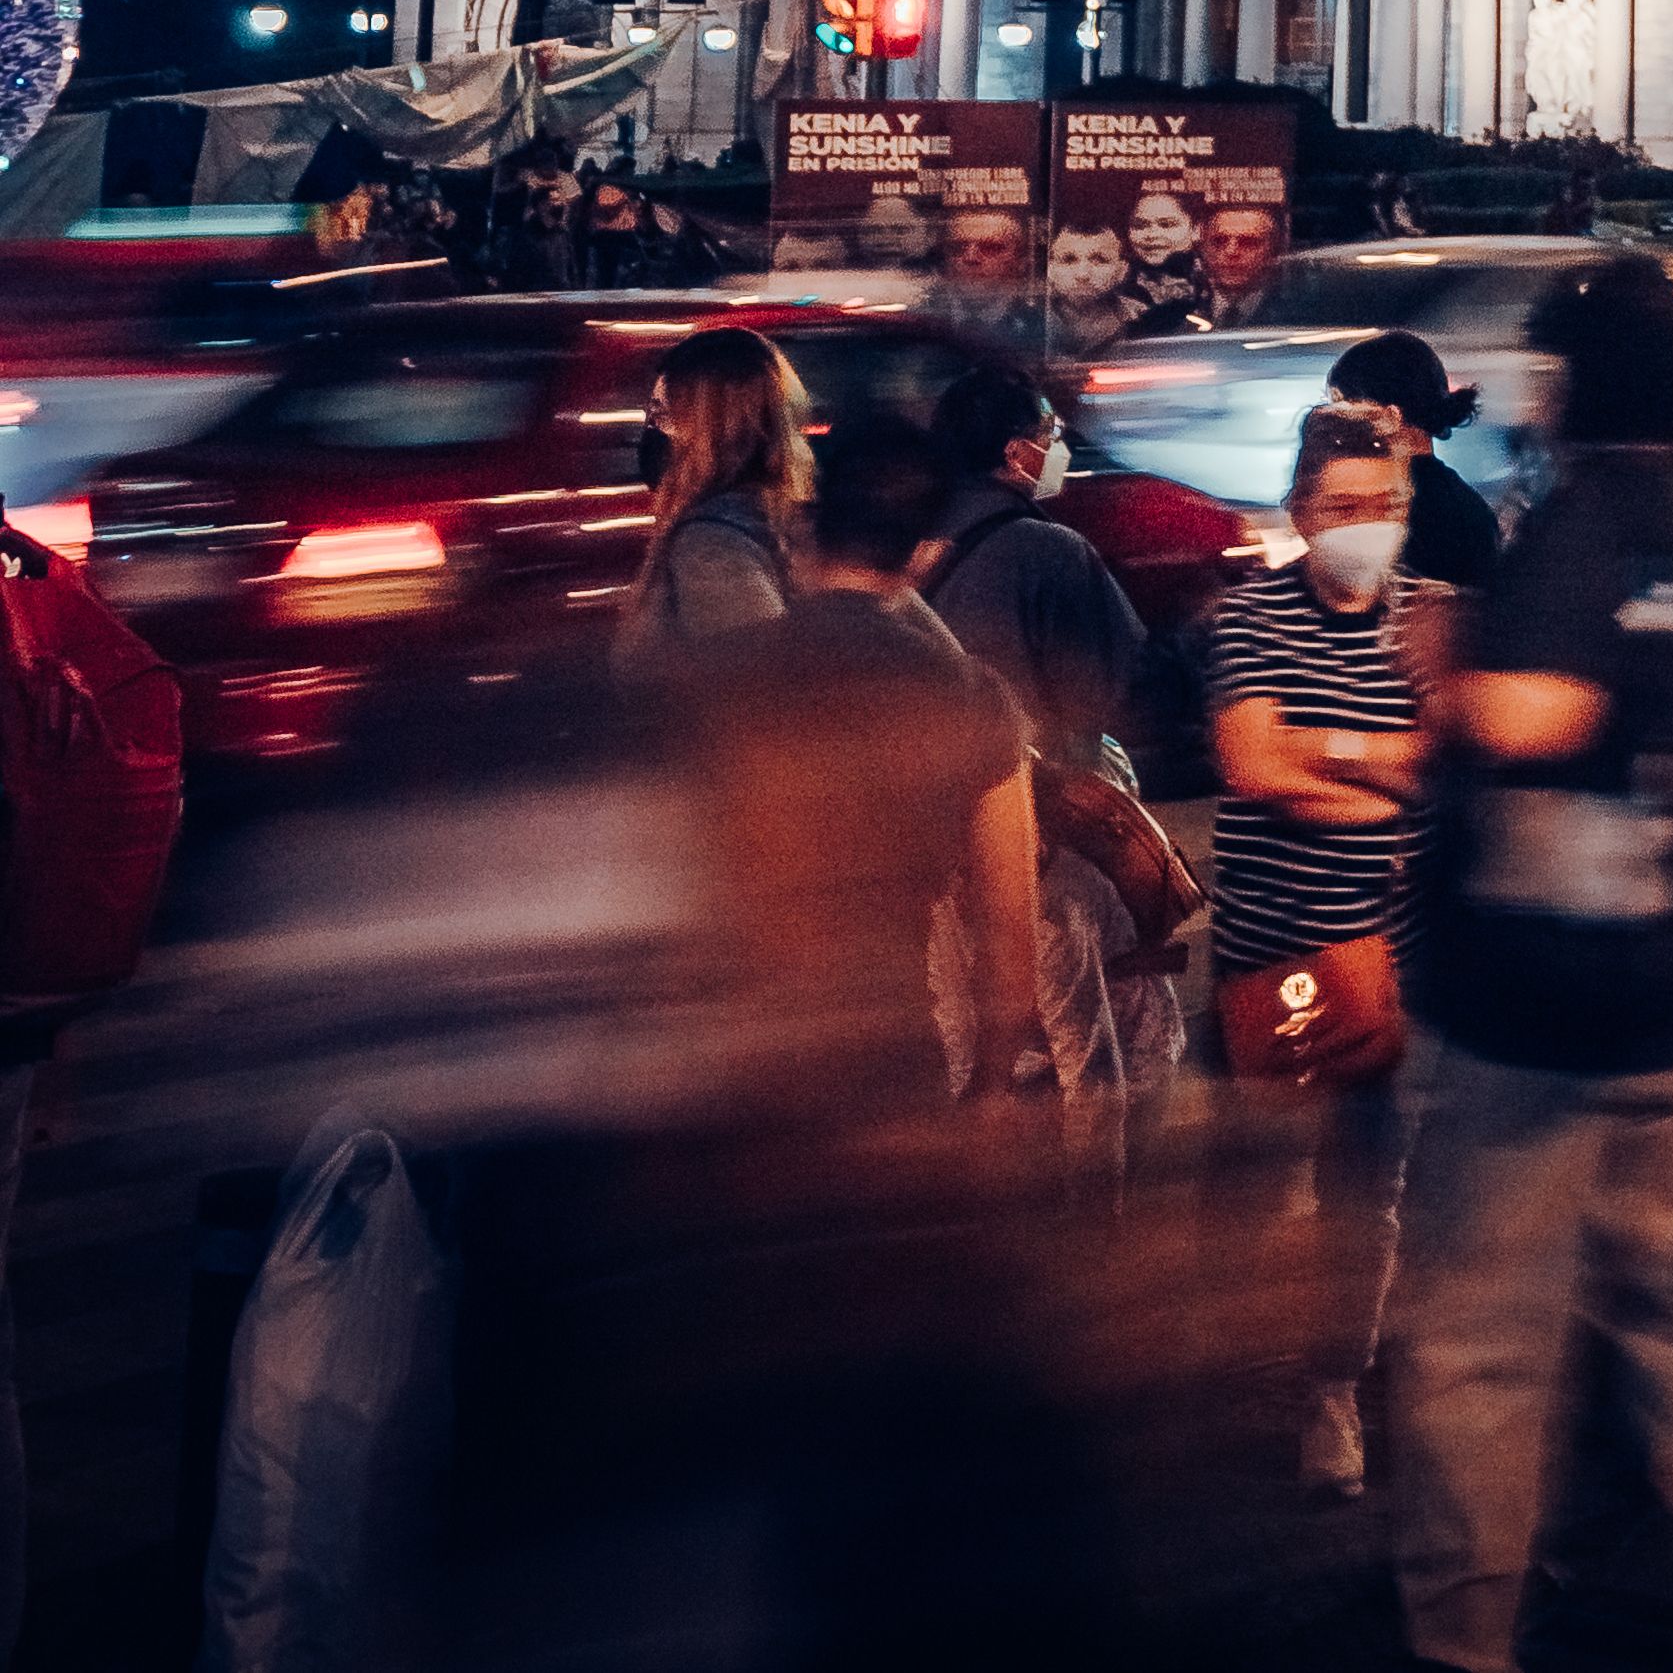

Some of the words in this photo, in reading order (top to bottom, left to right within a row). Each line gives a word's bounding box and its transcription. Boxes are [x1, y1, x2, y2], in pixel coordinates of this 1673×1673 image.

[789, 113, 890, 133] KENIA
[897, 114, 921, 133] Y
[1067, 115, 1159, 134] KENIA
[1165, 116, 1186, 134] Y
[789, 135, 951, 155] SUNSHINE
[1066, 136, 1214, 155] SUNSHINE
[788, 157, 820, 171] EN
[1066, 156, 1095, 169] EN
